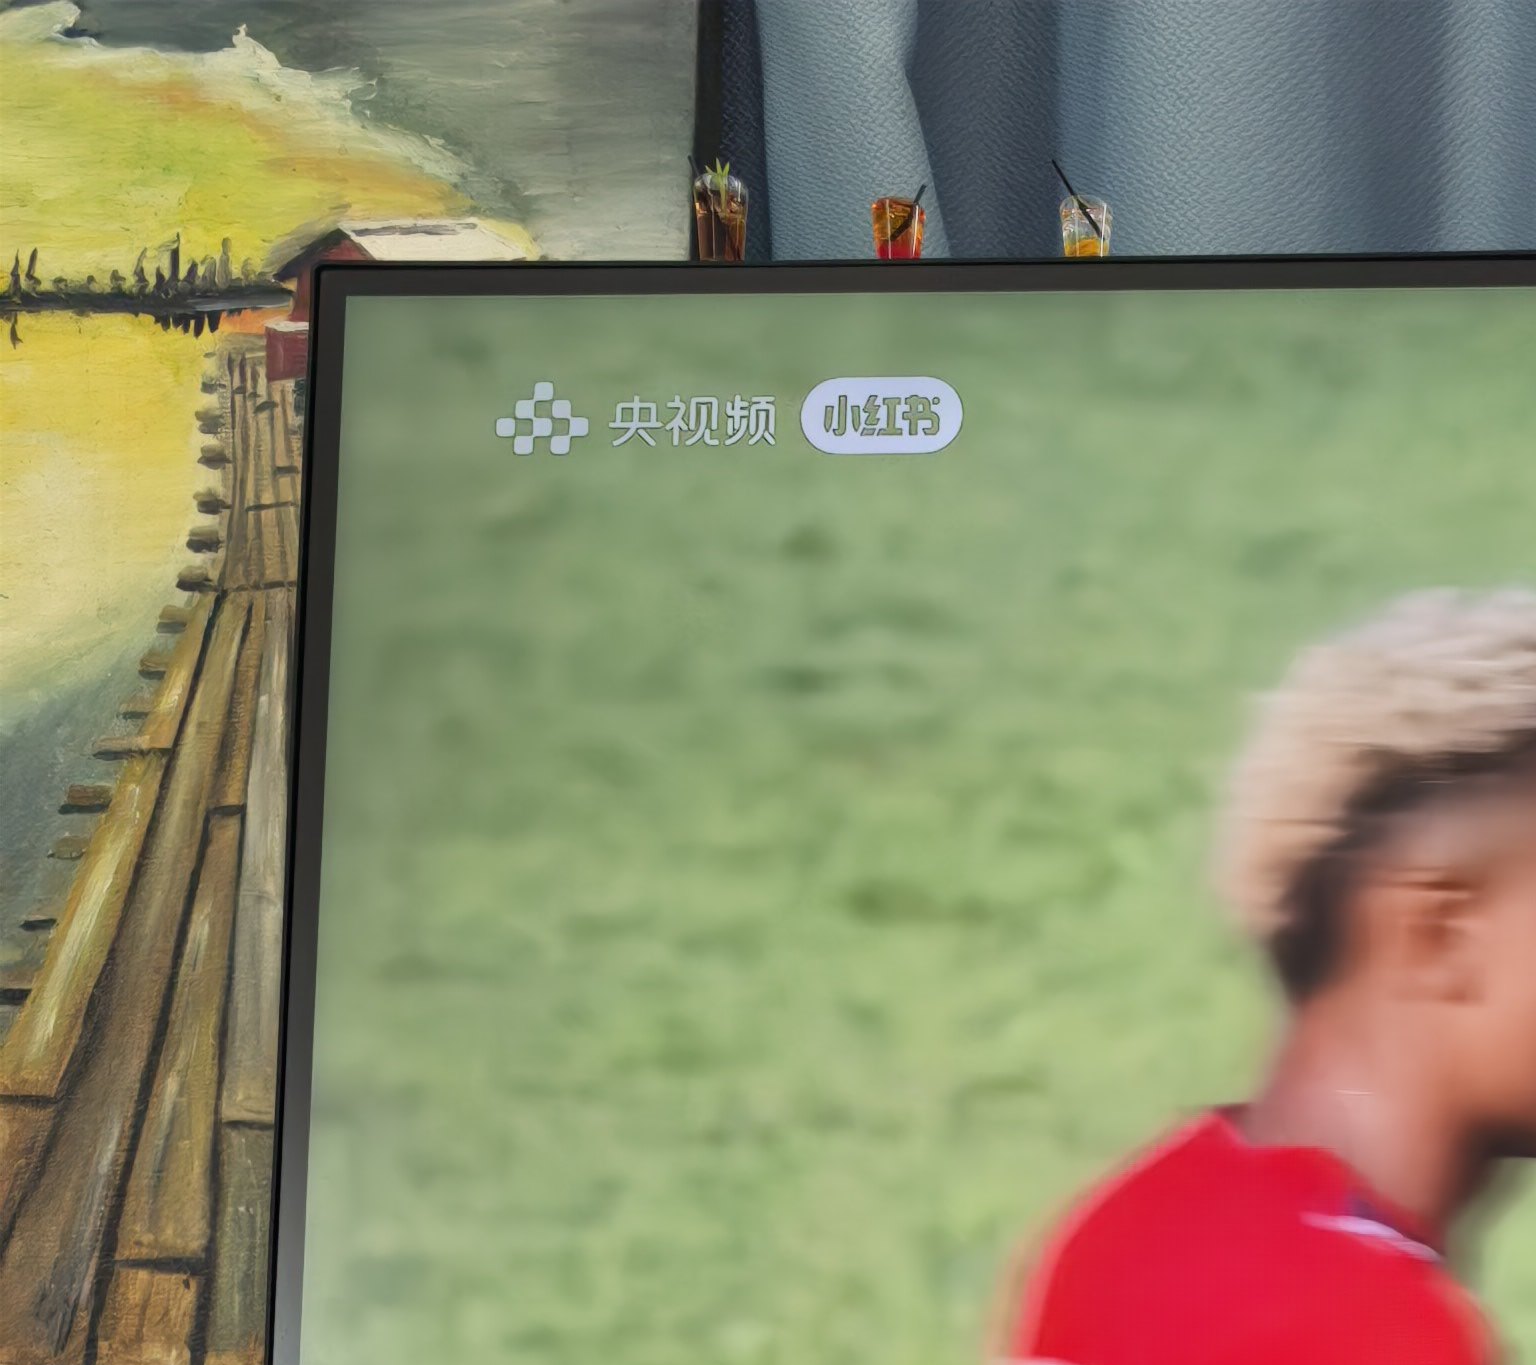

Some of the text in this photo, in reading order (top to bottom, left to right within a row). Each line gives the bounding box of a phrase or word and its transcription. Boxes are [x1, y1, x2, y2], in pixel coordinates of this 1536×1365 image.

[608, 394, 778, 447] 央视频
[822, 394, 942, 437] 小红书
